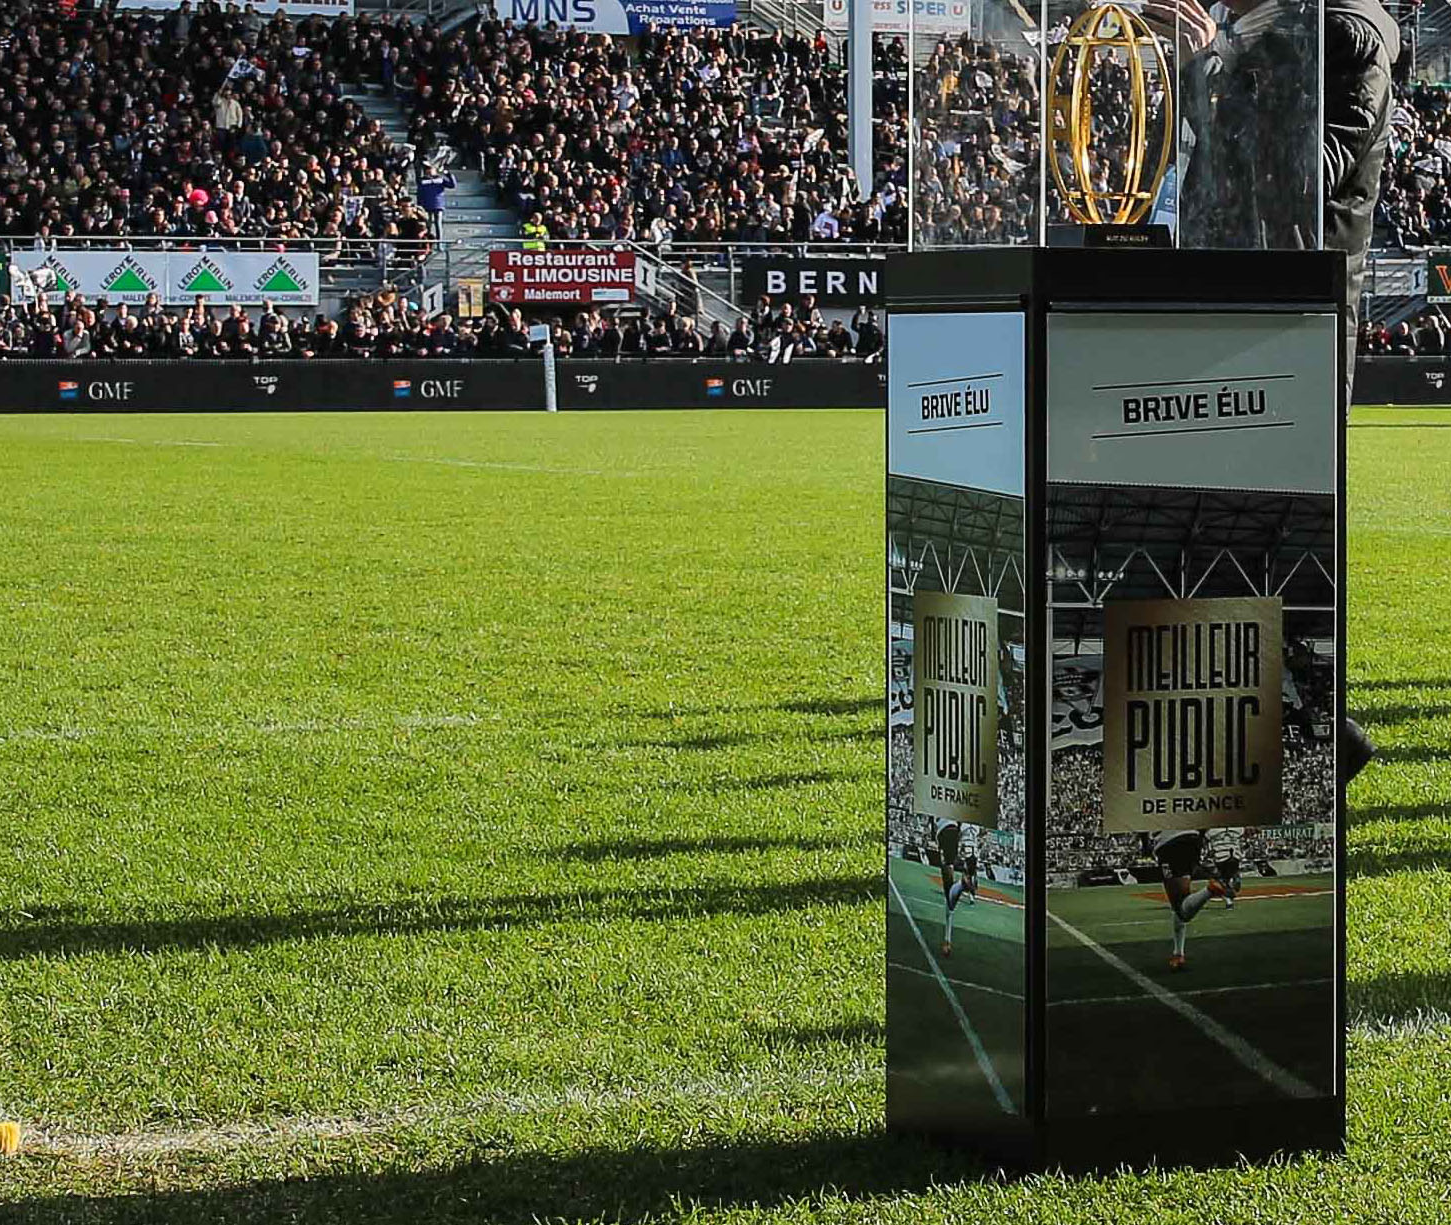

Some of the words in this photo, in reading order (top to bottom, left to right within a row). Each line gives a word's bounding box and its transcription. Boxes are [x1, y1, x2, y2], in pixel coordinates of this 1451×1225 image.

[625, 3, 666, 15] Achat
[668, 4, 707, 15] Vente
[47, 255, 81, 290] MERLIN
[100, 263, 127, 290] LEROY
[124, 255, 158, 290] MERLIN
[177, 262, 203, 290] LEROY
[201, 256, 234, 290] MERLIN
[253, 263, 279, 290] LEROY
[277, 256, 309, 290] MERLIN
[490, 269, 515, 283] La
[523, 268, 634, 283] LIMOUSINE
[507, 253, 617, 266] Restaurant
[524, 288, 581, 301] Malemort
[88, 381, 135, 401] GMF
[420, 380, 463, 398] GMF
[732, 379, 773, 397] GMF
[921, 390, 962, 420] BRIVE
[965, 385, 990, 415] ÉLU
[1122, 393, 1209, 424] BRIVE
[1217, 386, 1266, 418] ÉLU
[923, 616, 987, 687] MEILLEUR
[1126, 621, 1261, 692] MEILLEUR
[924, 687, 987, 785] PUBLIC
[1126, 695, 1261, 791] PUBLIC
[930, 784, 942, 803] DE
[944, 787, 981, 809] FRANCE
[1142, 796, 1167, 815] DE
[1171, 794, 1246, 814] FRANCE
